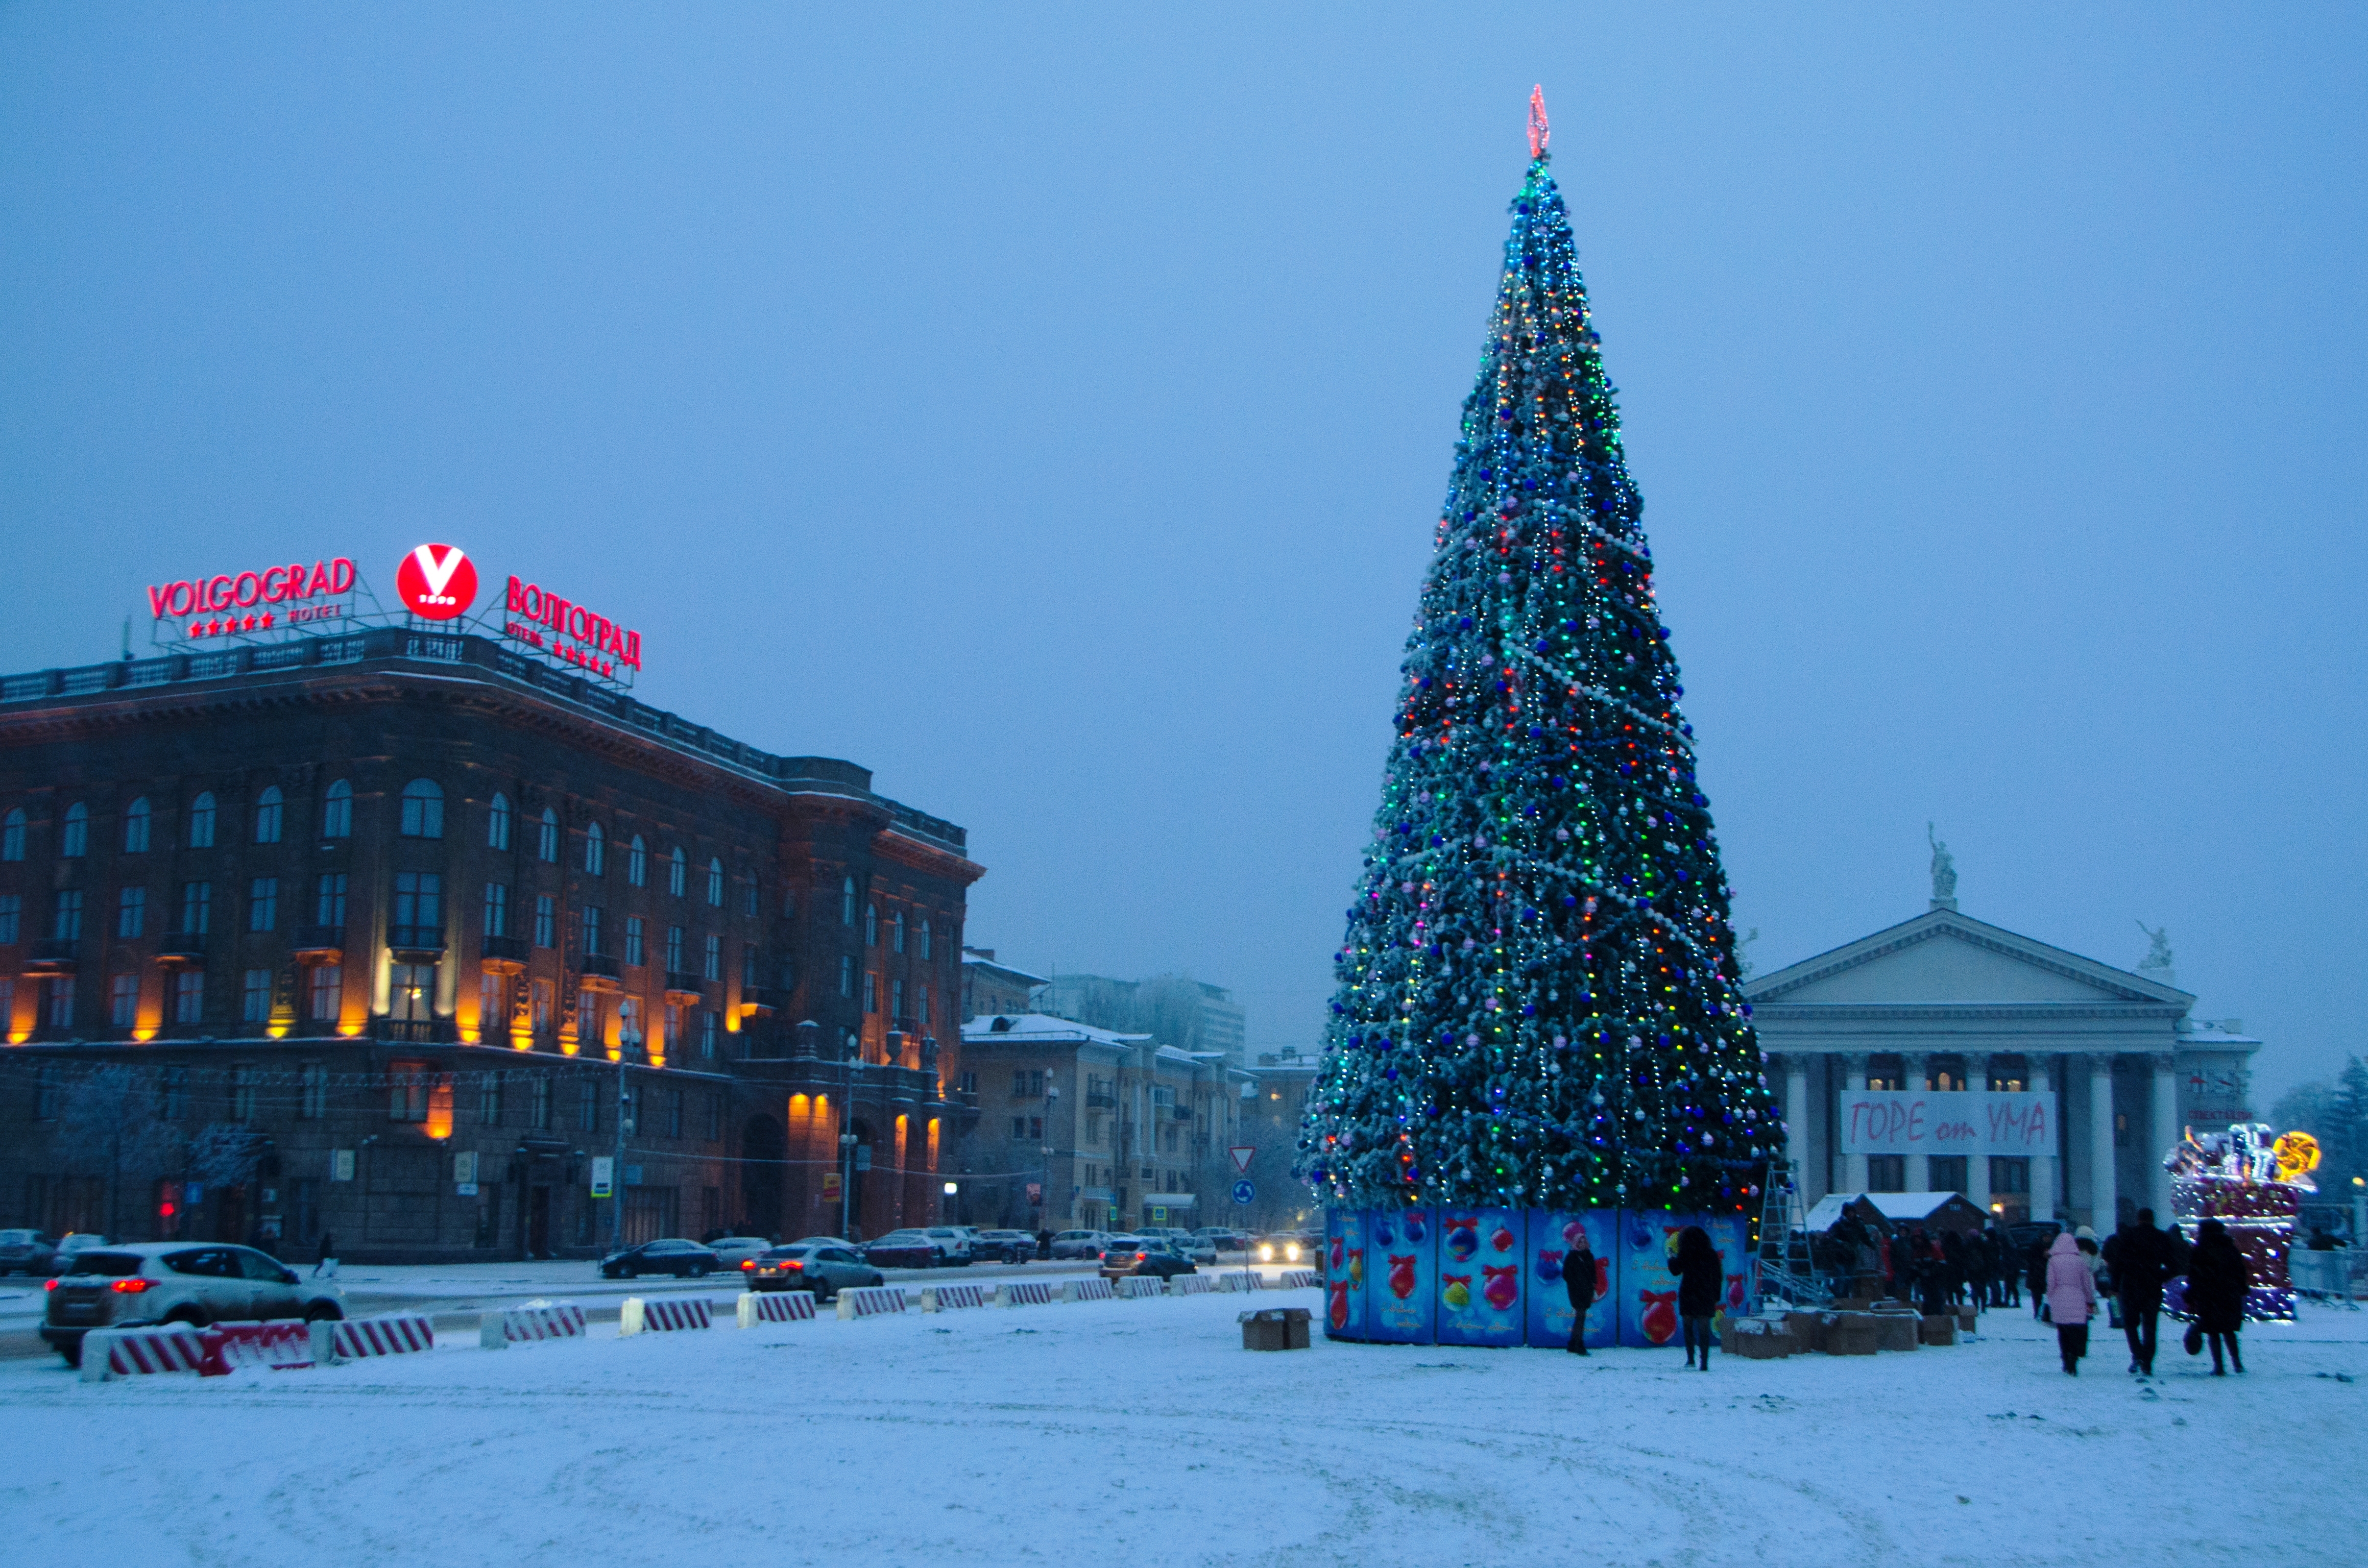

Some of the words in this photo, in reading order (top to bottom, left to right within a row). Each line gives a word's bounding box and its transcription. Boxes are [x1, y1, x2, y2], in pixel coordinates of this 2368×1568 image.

[148, 557, 354, 619] VOLGOGRAD
[415, 544, 464, 596] V
[288, 604, 342, 623] HOTEL
[506, 575, 642, 671] ВОЛГОГРАД
[506, 621, 544, 647] ОТЕЛЬ
[1851, 1100, 1925, 1144] ГОРЕ
[1987, 1101, 2045, 1145] УМА
